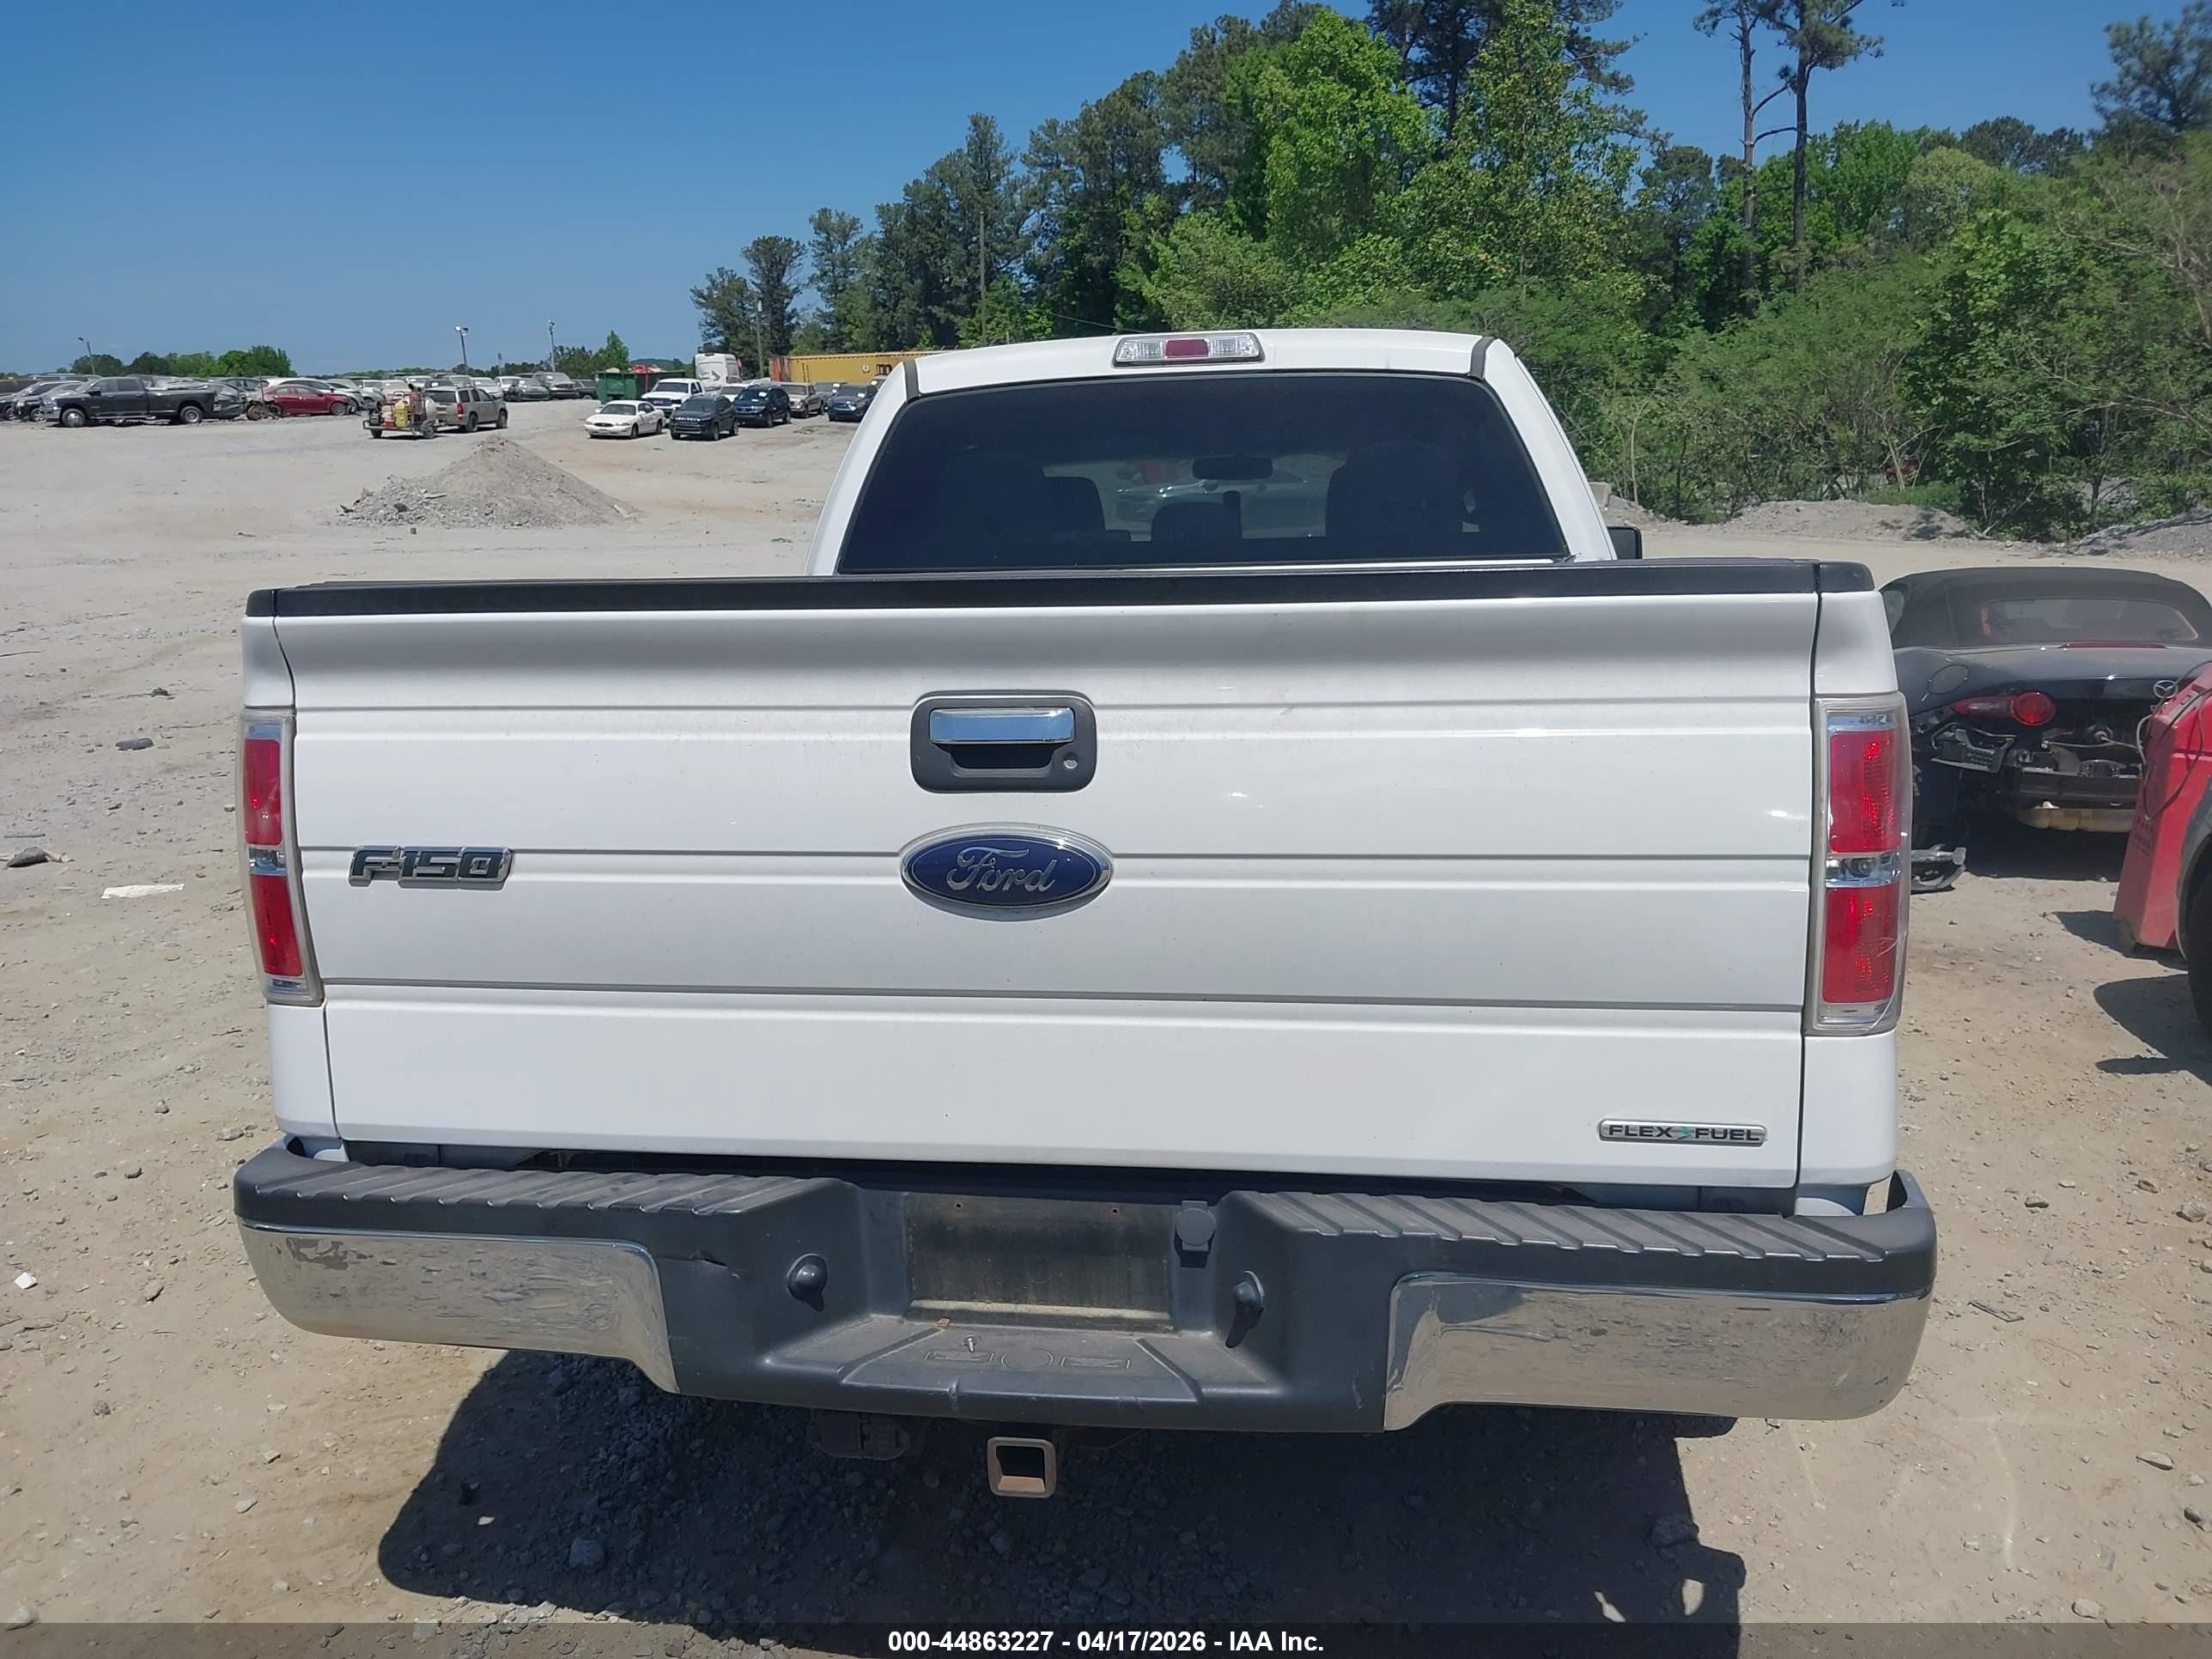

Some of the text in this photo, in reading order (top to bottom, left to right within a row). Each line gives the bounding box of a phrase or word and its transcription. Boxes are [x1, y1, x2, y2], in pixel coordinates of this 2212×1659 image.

[946, 846, 1058, 892] Ford
[1608, 1124, 1760, 1141] FLEX FUEL
